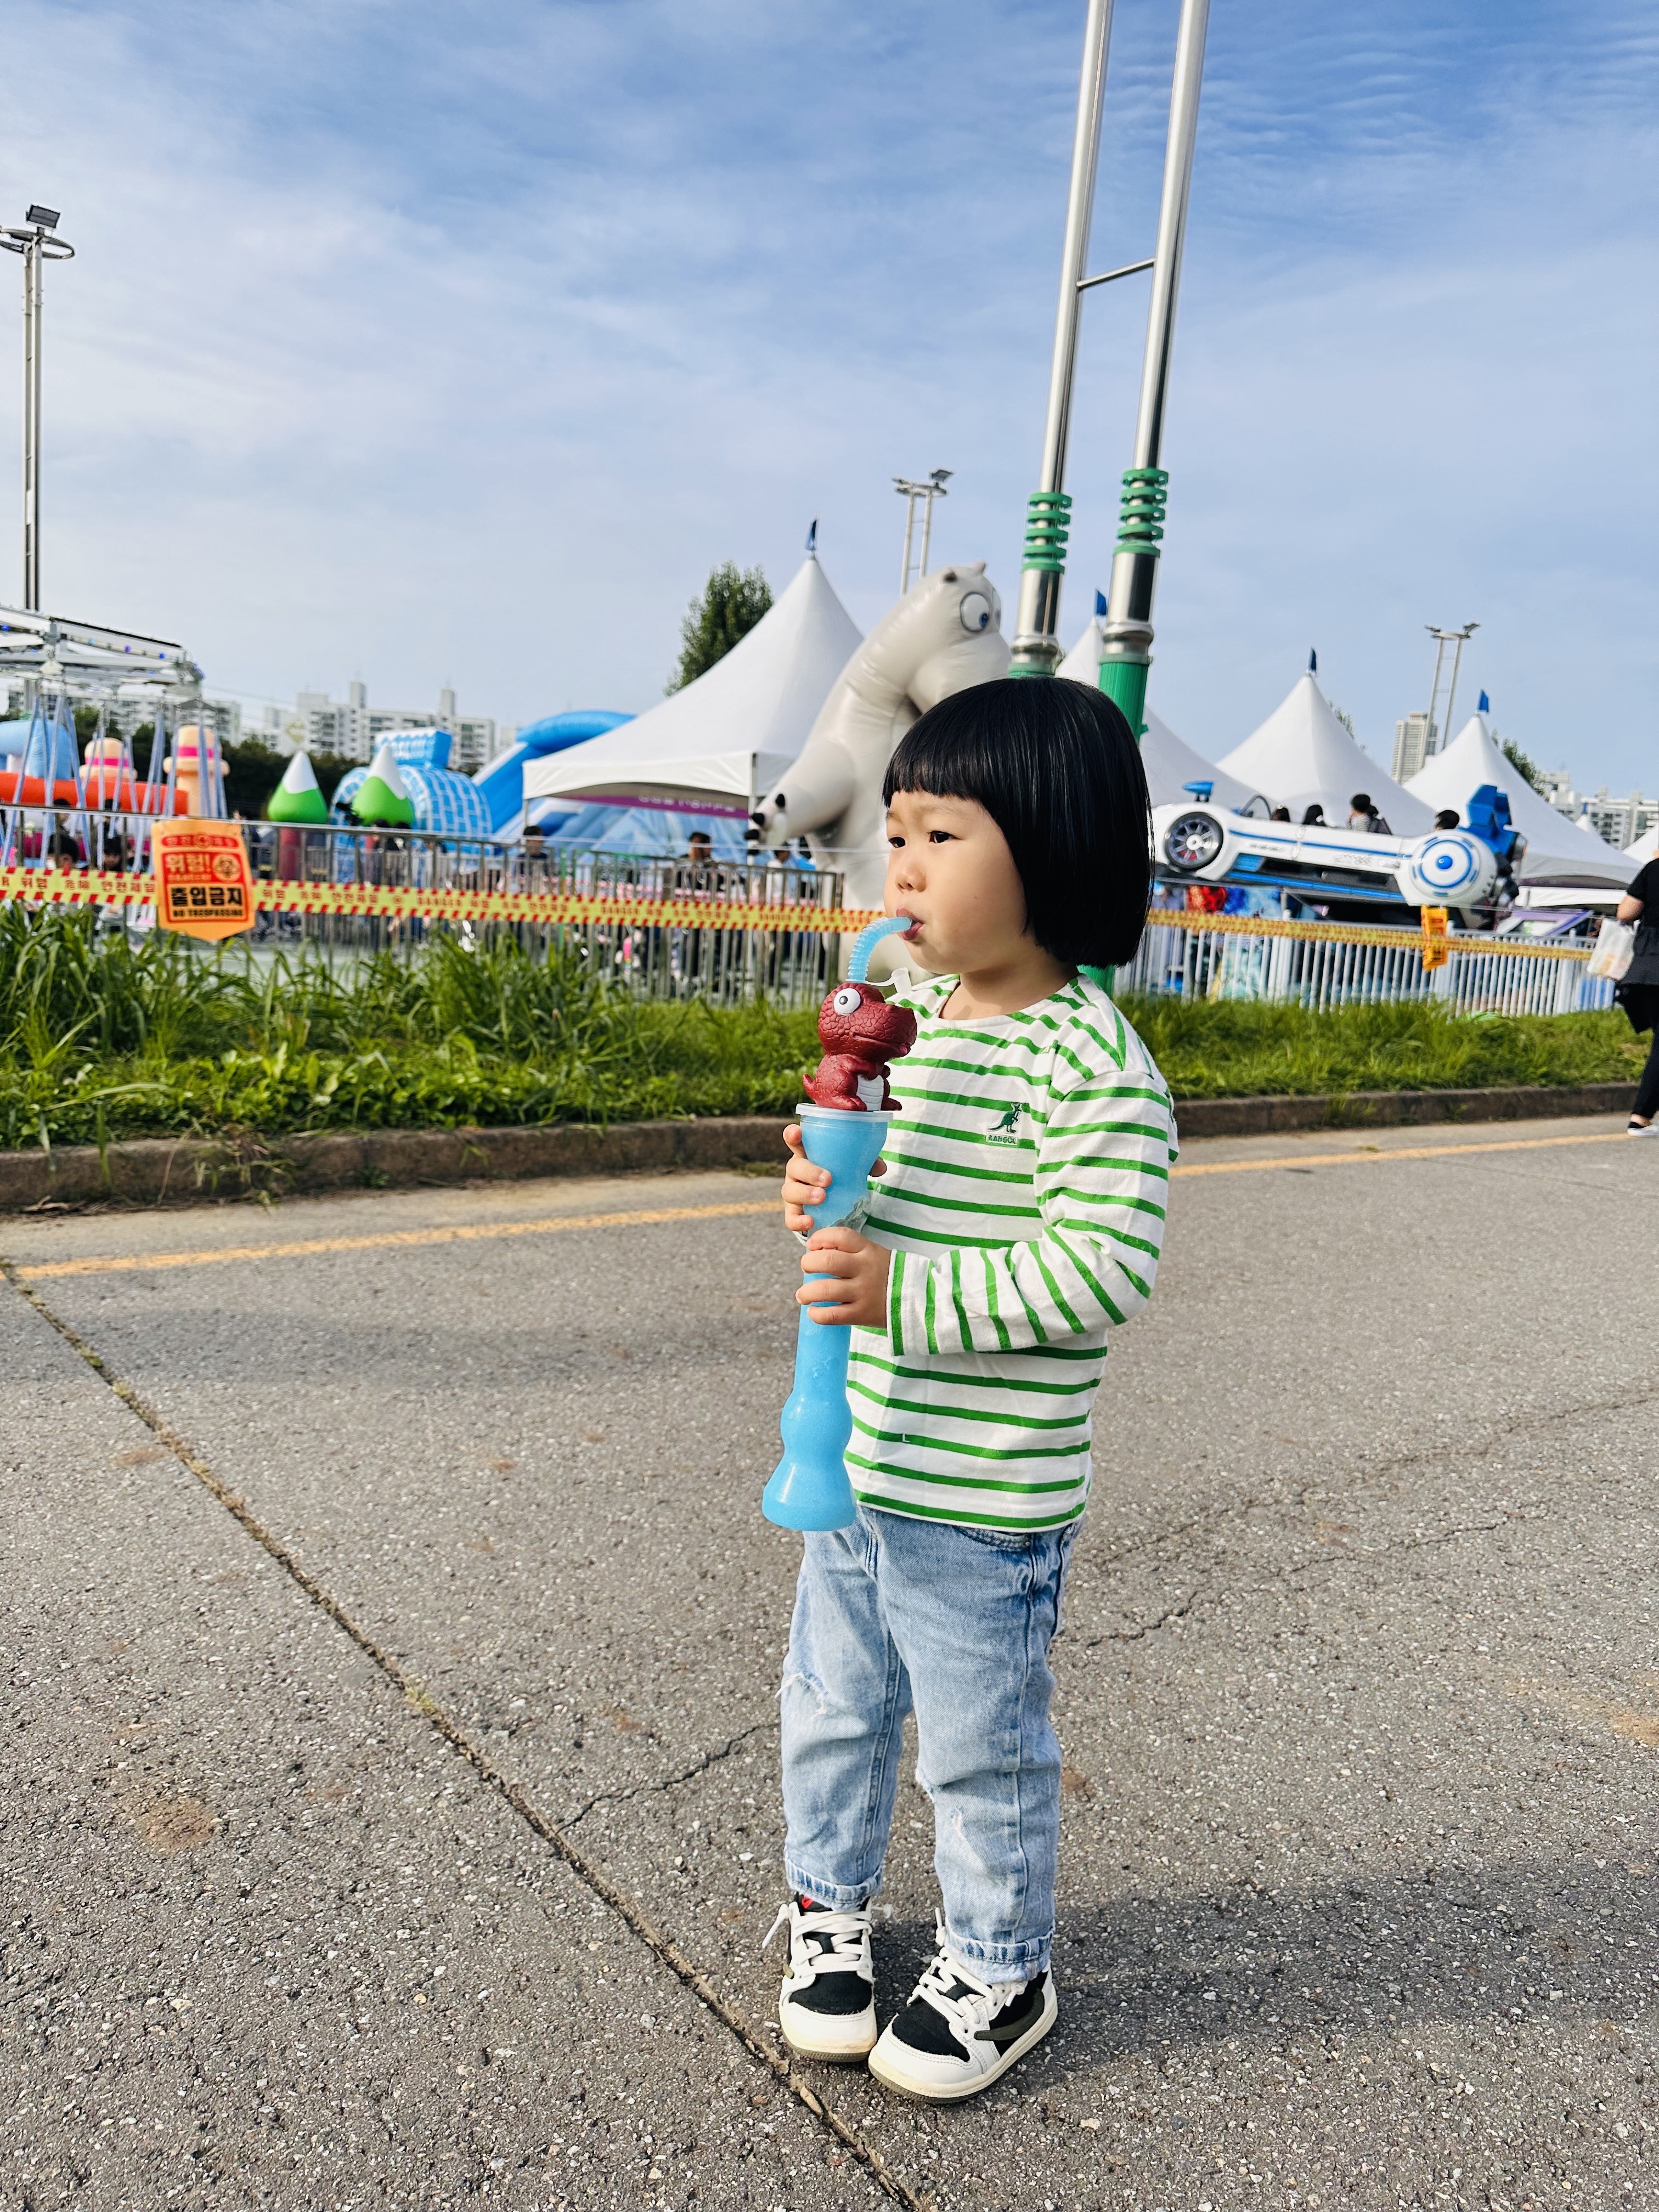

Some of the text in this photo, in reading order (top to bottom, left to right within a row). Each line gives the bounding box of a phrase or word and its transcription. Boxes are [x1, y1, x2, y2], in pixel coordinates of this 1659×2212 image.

[166, 853, 211, 873] 위험!
[171, 887, 242, 906] 출입금지
[988, 1135, 1016, 1144] KANGOL
[902, 1433, 911, 1442] L
